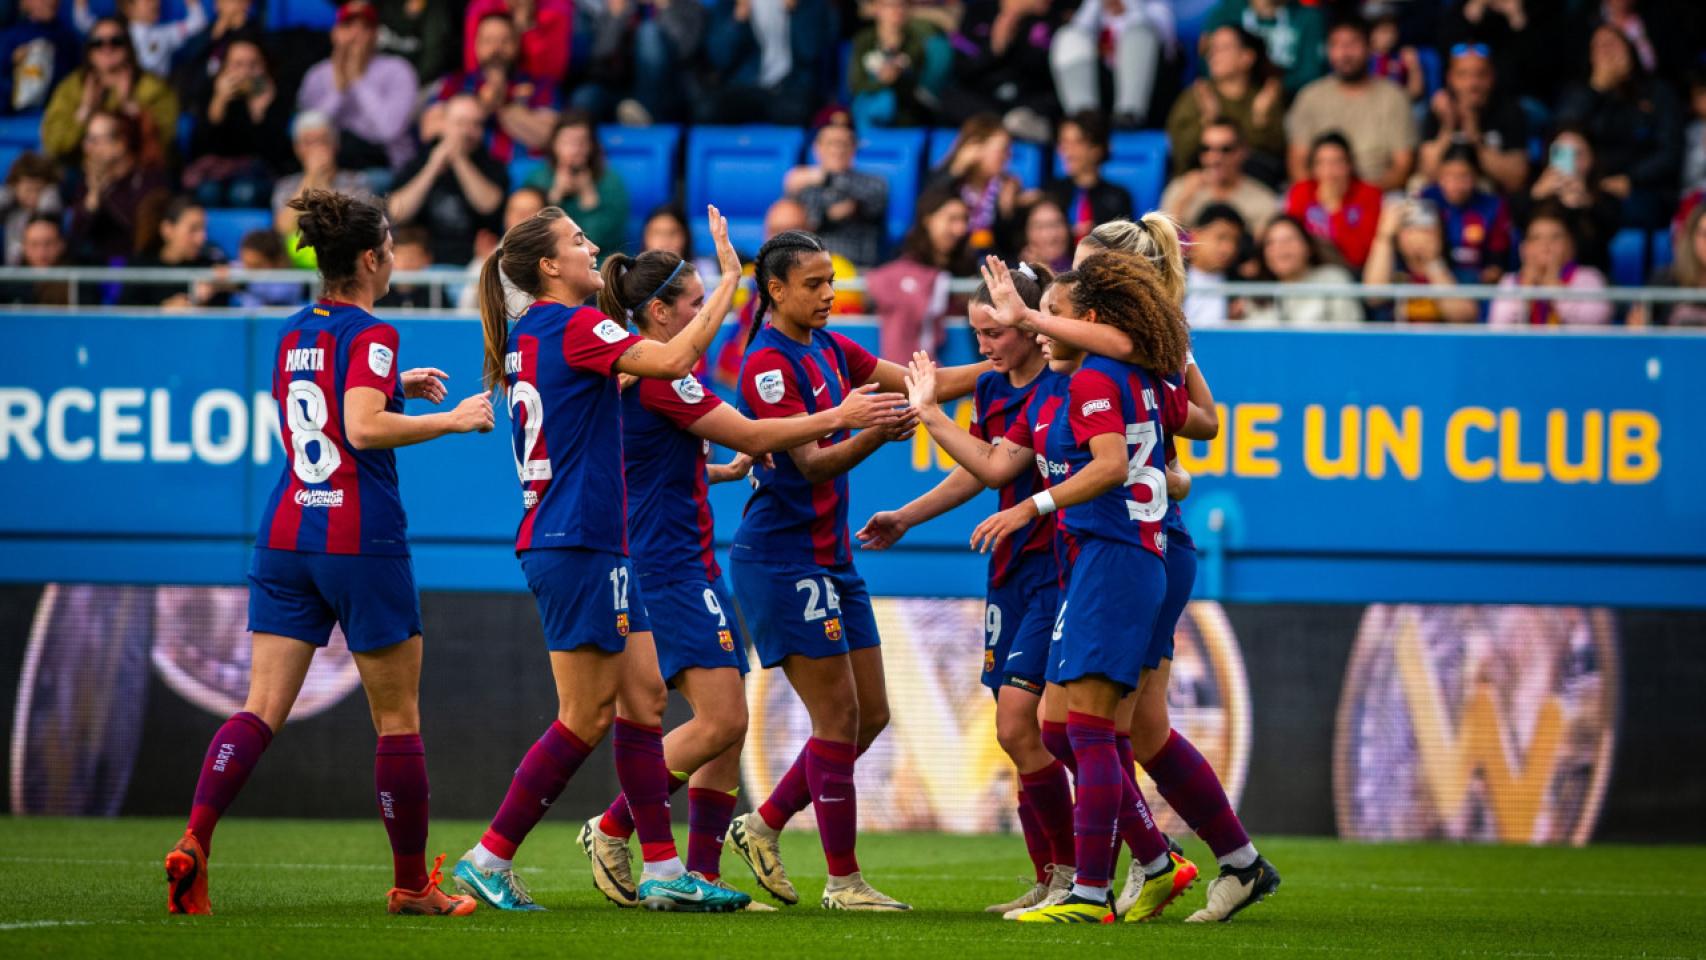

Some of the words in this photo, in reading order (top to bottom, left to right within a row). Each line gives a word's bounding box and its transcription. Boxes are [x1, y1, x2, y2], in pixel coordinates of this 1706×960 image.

[285, 348, 325, 372] MARTA
[286, 380, 342, 484] 8
[1173, 403, 1282, 477] UE
[1303, 404, 1422, 480] UN
[1444, 407, 1662, 484] CLUB
[1124, 420, 1168, 523] 3
[609, 566, 629, 610] 12
[703, 588, 726, 627] 9
[212, 743, 236, 772] BARÇA
